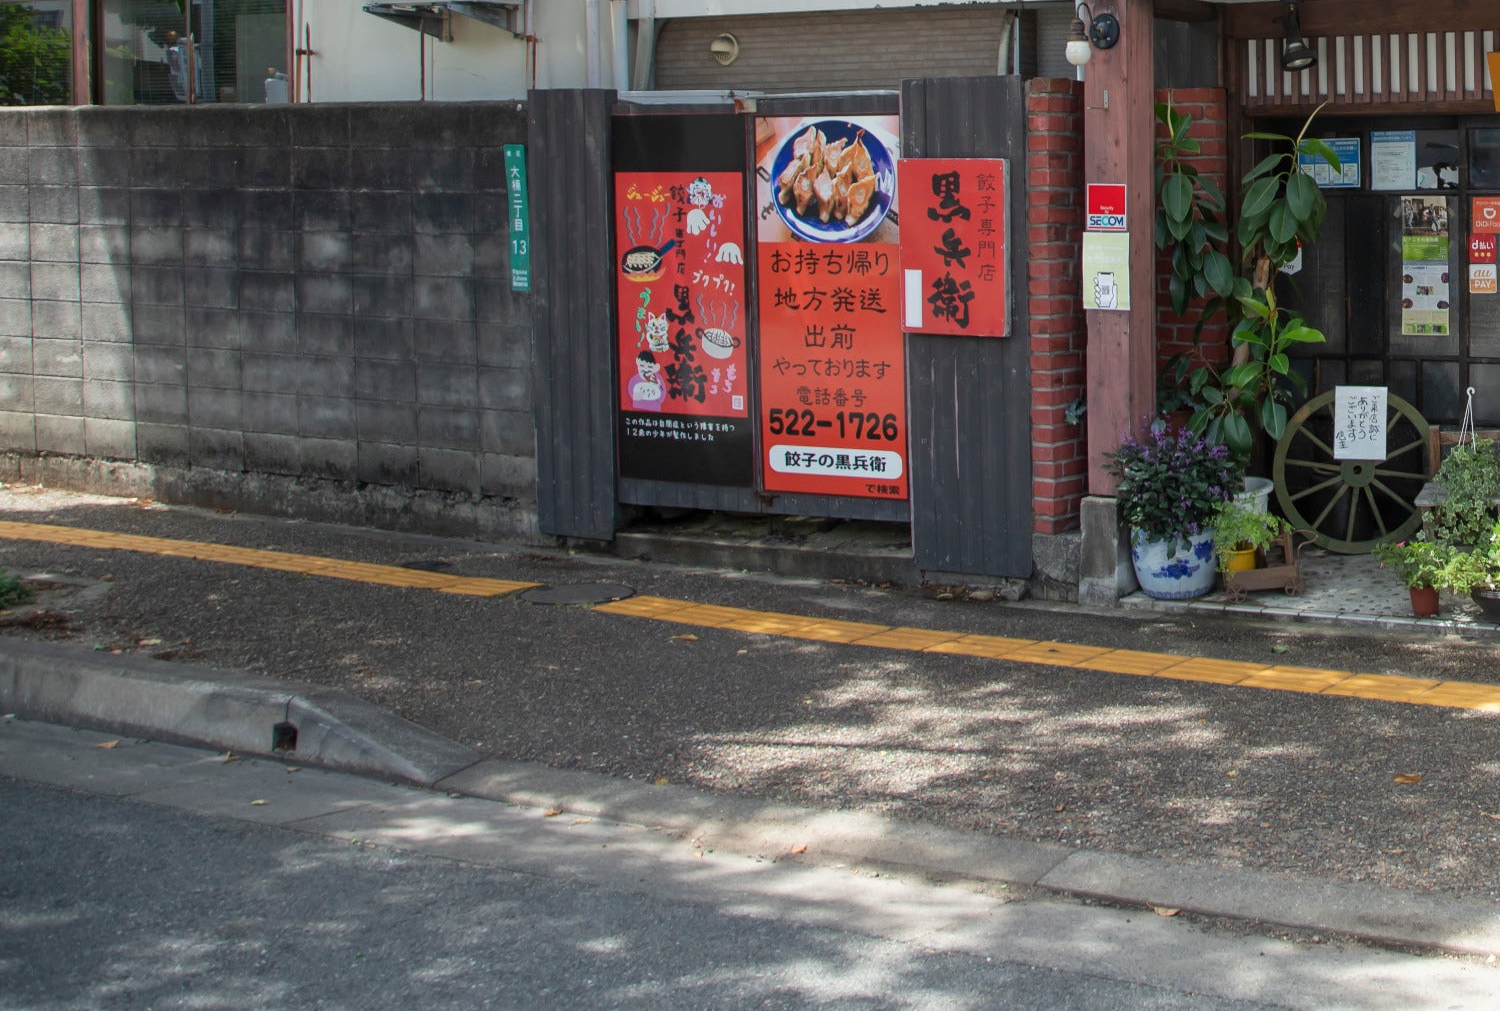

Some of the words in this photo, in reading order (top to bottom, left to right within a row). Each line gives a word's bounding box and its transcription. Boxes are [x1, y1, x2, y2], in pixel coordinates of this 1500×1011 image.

[976, 173, 997, 282] 餃子専門店
[1089, 215, 1124, 227] SECOM
[512, 240, 527, 255] 13
[927, 170, 976, 329] 黒兵衛
[1471, 239, 1494, 250] d払い
[770, 249, 889, 276] お持ち帰り
[1473, 269, 1492, 278] au
[1474, 279, 1492, 289] PAY
[774, 287, 887, 314] 地方発送
[664, 283, 708, 404] 黒兵衛
[804, 324, 856, 350] 出前
[772, 357, 891, 380] やっております
[796, 386, 867, 408] 電話番号
[769, 408, 898, 442] 522-1726
[1347, 395, 1358, 443] ございます
[1357, 396, 1369, 440] ありがとう
[784, 451, 887, 473] 餃子の黒兵衛
[865, 484, 901, 495] で検索
